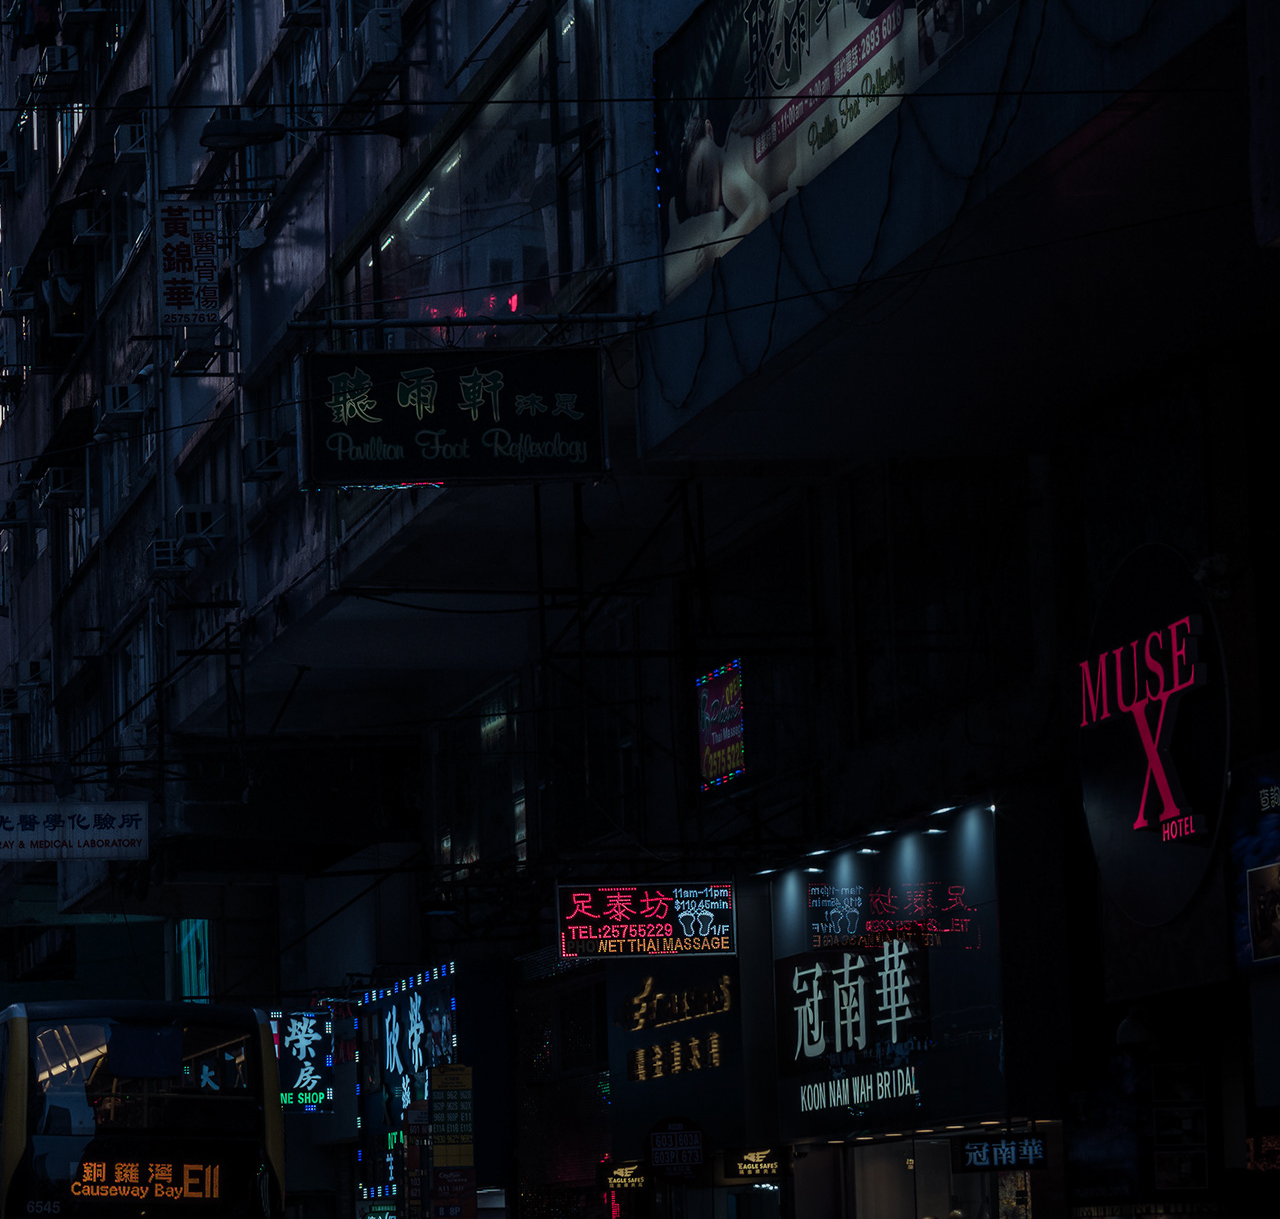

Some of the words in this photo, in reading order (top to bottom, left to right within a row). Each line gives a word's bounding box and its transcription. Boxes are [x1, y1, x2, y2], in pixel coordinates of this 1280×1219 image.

[160, 205, 195, 311] 黃錦華
[193, 205, 218, 310] 中醫骨傷
[325, 366, 505, 426] 聽雨軒
[514, 392, 585, 421] 沐足
[414, 428, 471, 460] Foot
[481, 427, 588, 464] Reflexology
[1078, 615, 1195, 729] MUSE
[1132, 684, 1182, 830] X
[1162, 814, 1196, 842] HOTEL
[18, 840, 25, 849] &
[30, 839, 73, 849] MEDICAL
[77, 838, 143, 849] LABORATORY
[565, 890, 674, 923] 足泰坊
[672, 887, 729, 900] 11am-11pm
[710, 924, 730, 936] 1/F
[626, 939, 661, 953] THAI
[662, 936, 730, 951] MASSAGE
[792, 938, 914, 1062] 冠南華
[284, 1016, 323, 1061] 榮
[293, 1060, 323, 1091] 房
[800, 1081, 827, 1112] KOON
[828, 1078, 851, 1108] NAM
[851, 1074, 874, 1105] WAH
[876, 1066, 920, 1100] BRIDAL
[297, 1092, 326, 1105] SHOP
[655, 1135, 673, 1148] 603
[678, 1133, 700, 1146] 603A
[964, 1138, 1046, 1167] 冠南華
[654, 1150, 676, 1164] 603P
[681, 1150, 700, 1163] 673
[737, 1162, 758, 1170] EAGLE
[759, 1161, 779, 1170] SAFES
[81, 1161, 174, 1184] 銅鑼灣
[182, 1163, 220, 1199] E11
[607, 1176, 627, 1184] EAGLE
[627, 1175, 645, 1184] SAFES
[70, 1181, 150, 1200] Causeway
[154, 1182, 184, 1201] Bay
[26, 1200, 61, 1214] 6545
[438, 1205, 445, 1216] 8
[449, 1205, 461, 1216] 8P
